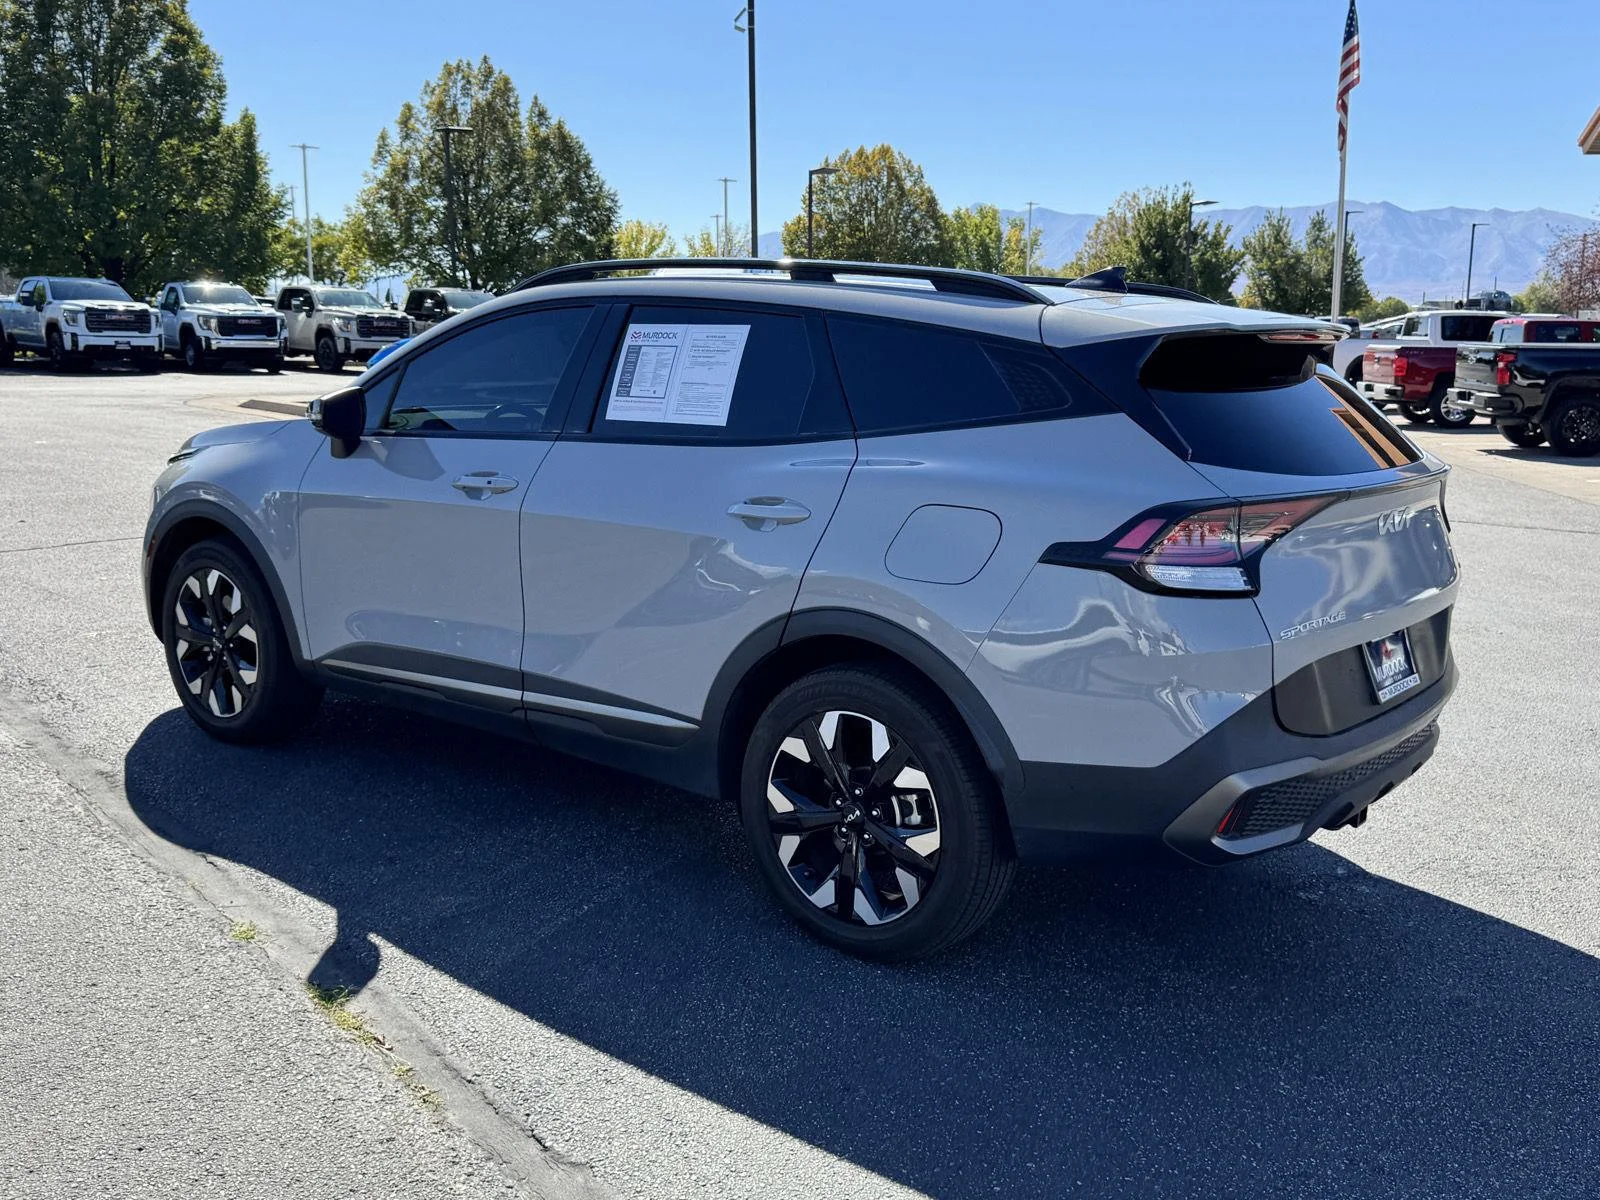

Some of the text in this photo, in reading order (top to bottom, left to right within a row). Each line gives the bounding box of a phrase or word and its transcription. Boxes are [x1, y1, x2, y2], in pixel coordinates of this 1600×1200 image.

[641, 331, 679, 340] MURDOCK
[1280, 610, 1346, 640] SPORTAGE
[1376, 656, 1409, 683] MURDOCK
[1387, 679, 1410, 696] MURDOCK
